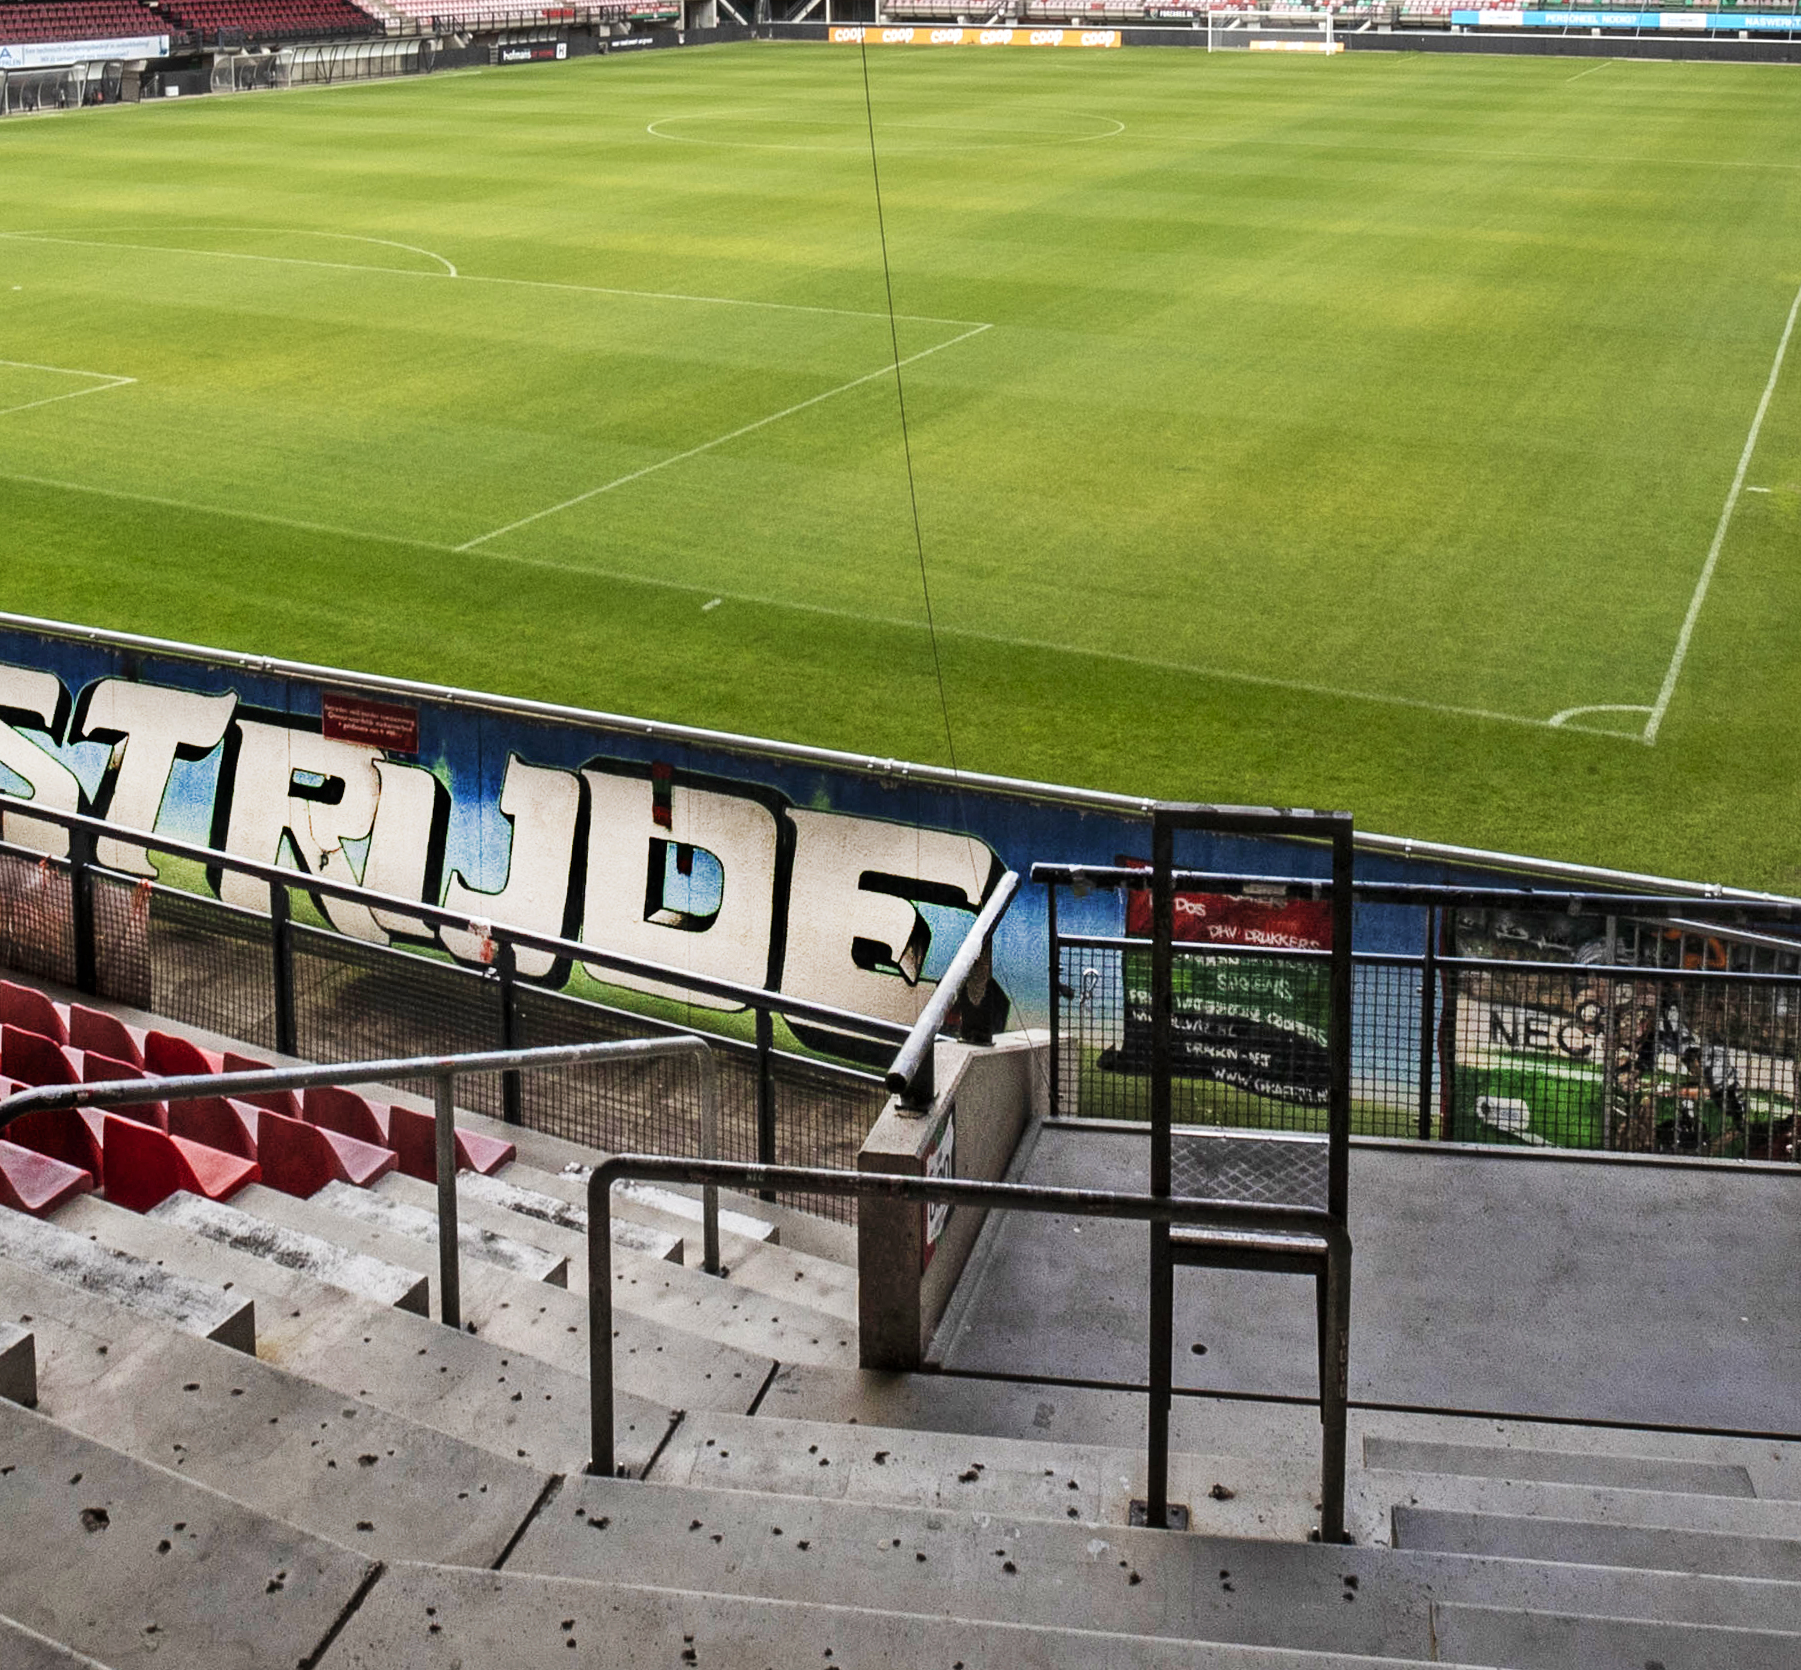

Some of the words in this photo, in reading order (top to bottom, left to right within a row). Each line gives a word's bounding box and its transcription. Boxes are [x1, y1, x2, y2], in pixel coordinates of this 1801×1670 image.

[1545, 14, 1598, 25] PERSONEEL
[834, 26, 865, 42] coop
[882, 27, 914, 43] coop
[930, 28, 963, 44] coop
[979, 29, 1013, 44] coop
[1030, 29, 1064, 46] coop
[1081, 30, 1115, 48] coop
